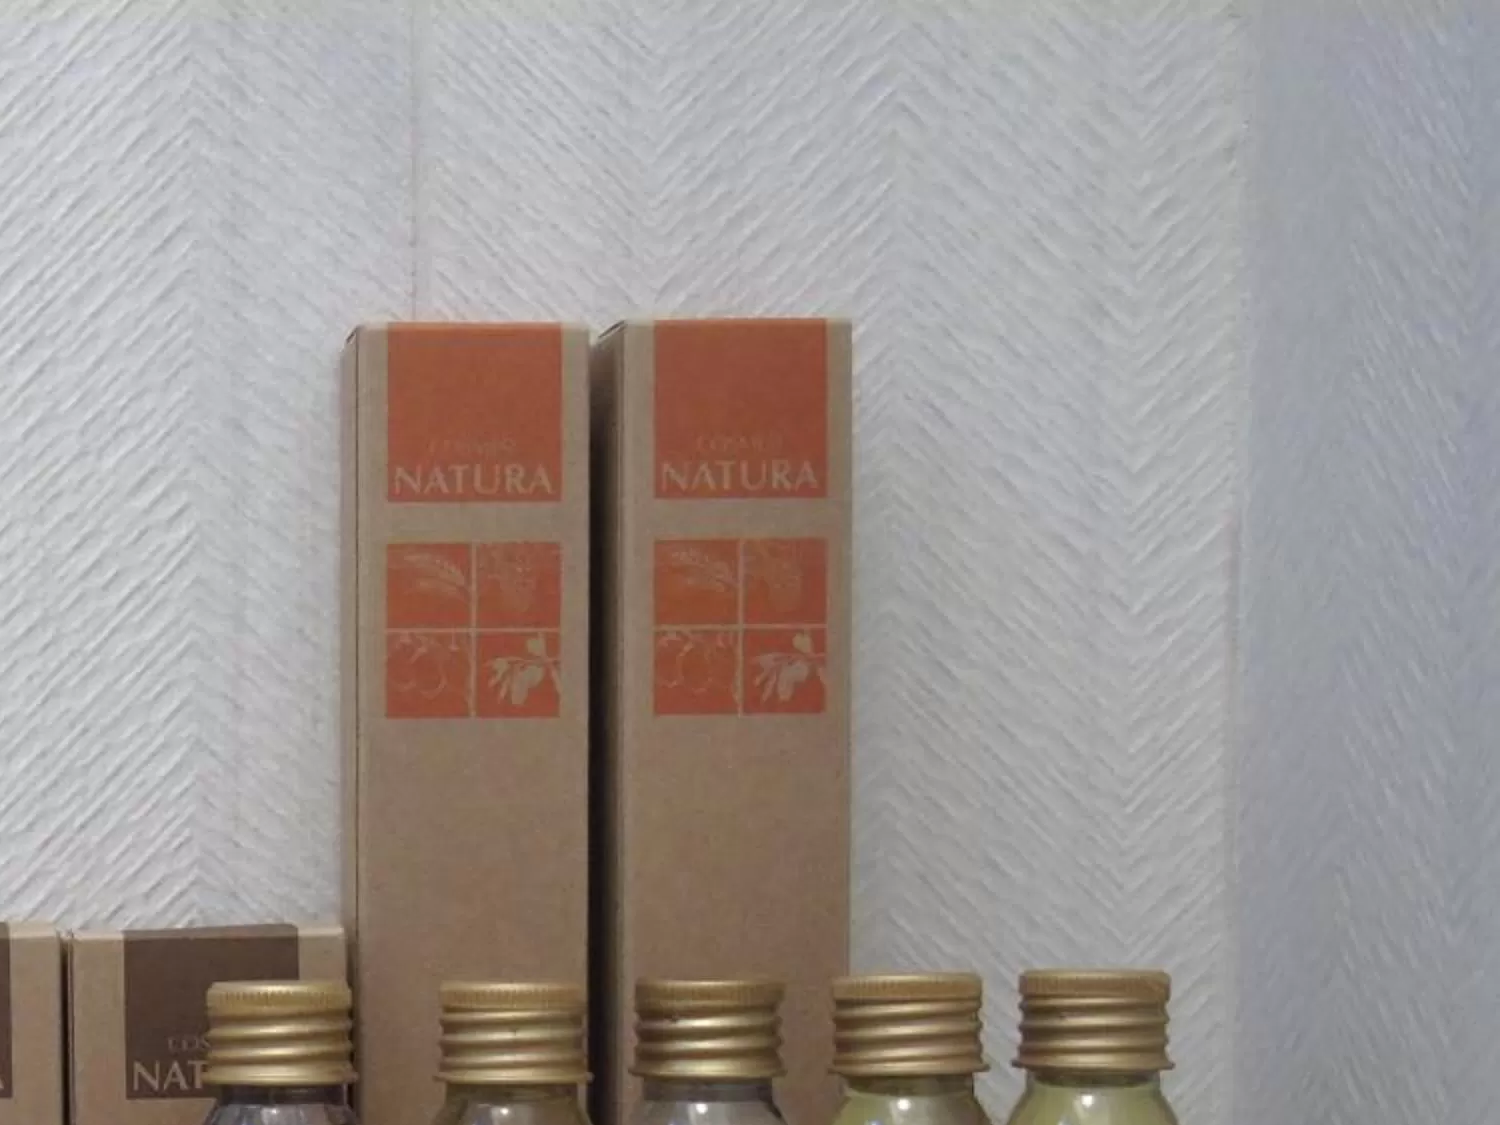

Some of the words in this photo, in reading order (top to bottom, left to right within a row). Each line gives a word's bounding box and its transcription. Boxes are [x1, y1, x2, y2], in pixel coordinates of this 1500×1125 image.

[393, 463, 555, 496] NATURA
[660, 459, 820, 492] NATURA
[133, 1060, 206, 1091] NAT
